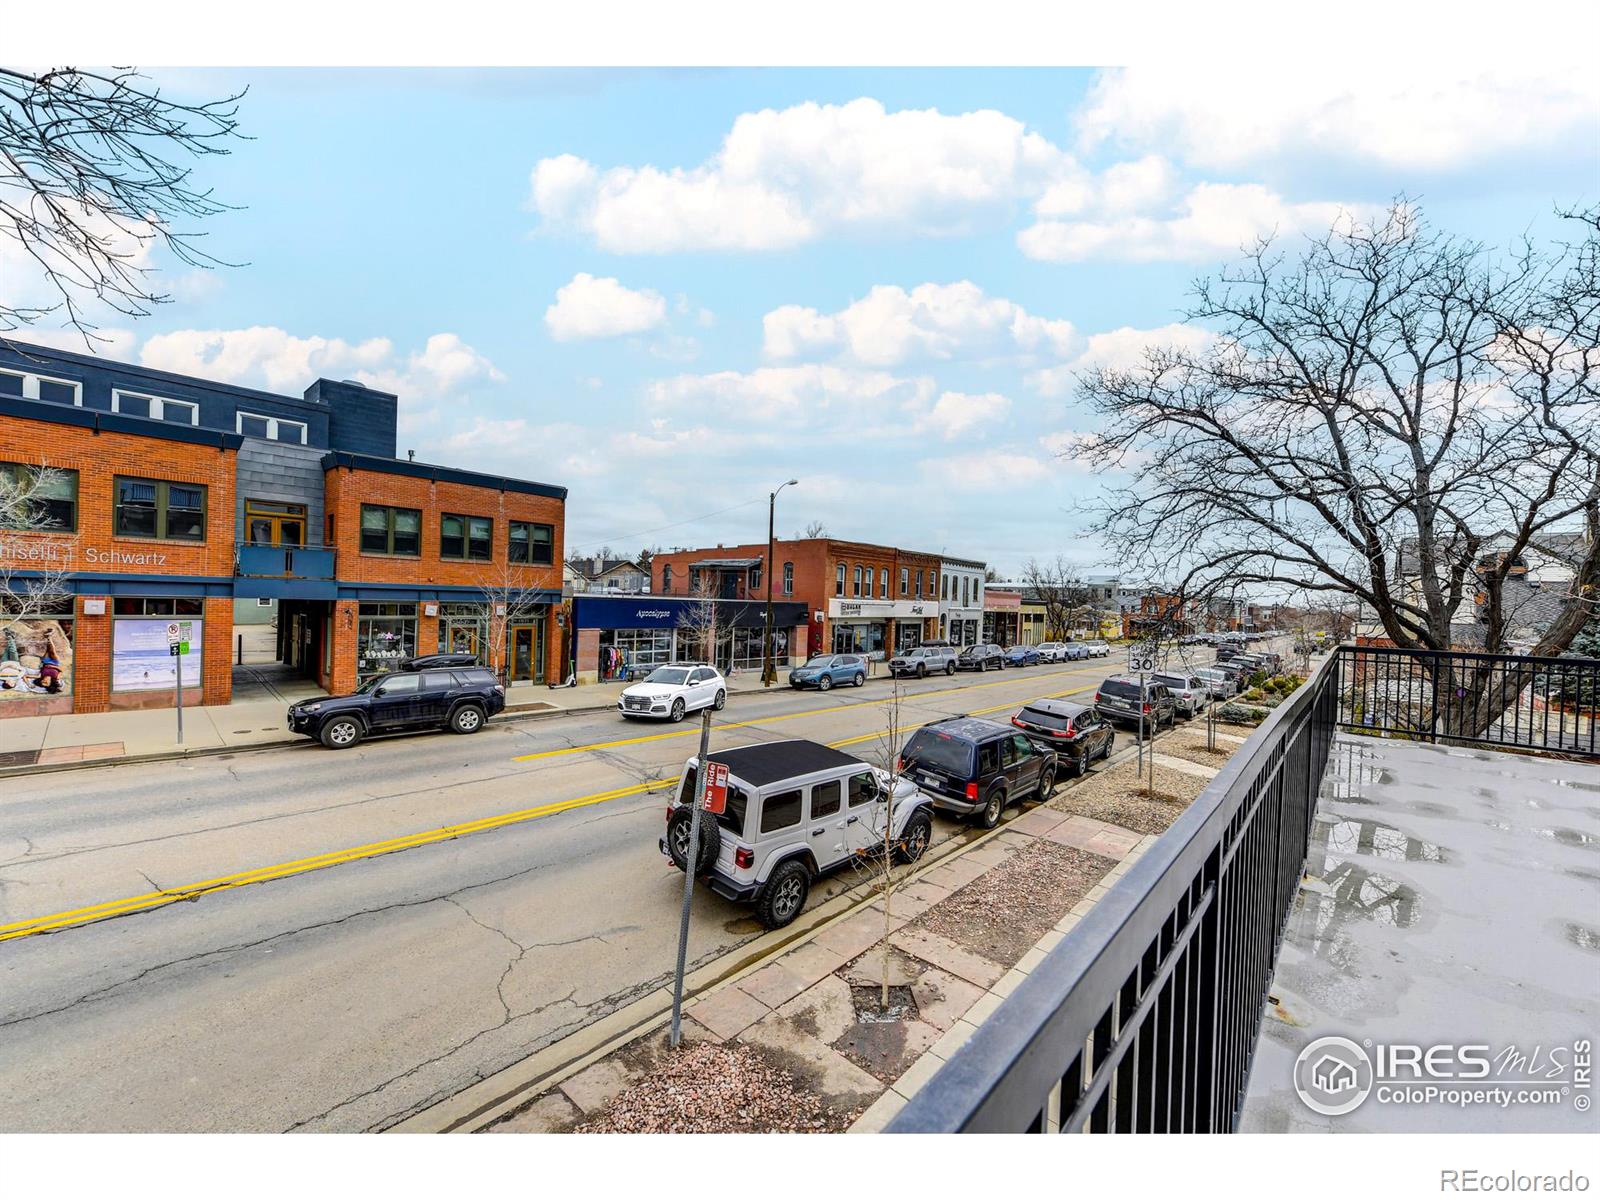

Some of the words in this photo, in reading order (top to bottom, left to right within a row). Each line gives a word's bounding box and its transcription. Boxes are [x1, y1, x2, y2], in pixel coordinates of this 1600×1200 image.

[86, 548, 166, 566] Schwartz
[1131, 658, 1152, 670] 30
[707, 764, 716, 786] Ride
[704, 790, 713, 809] The
